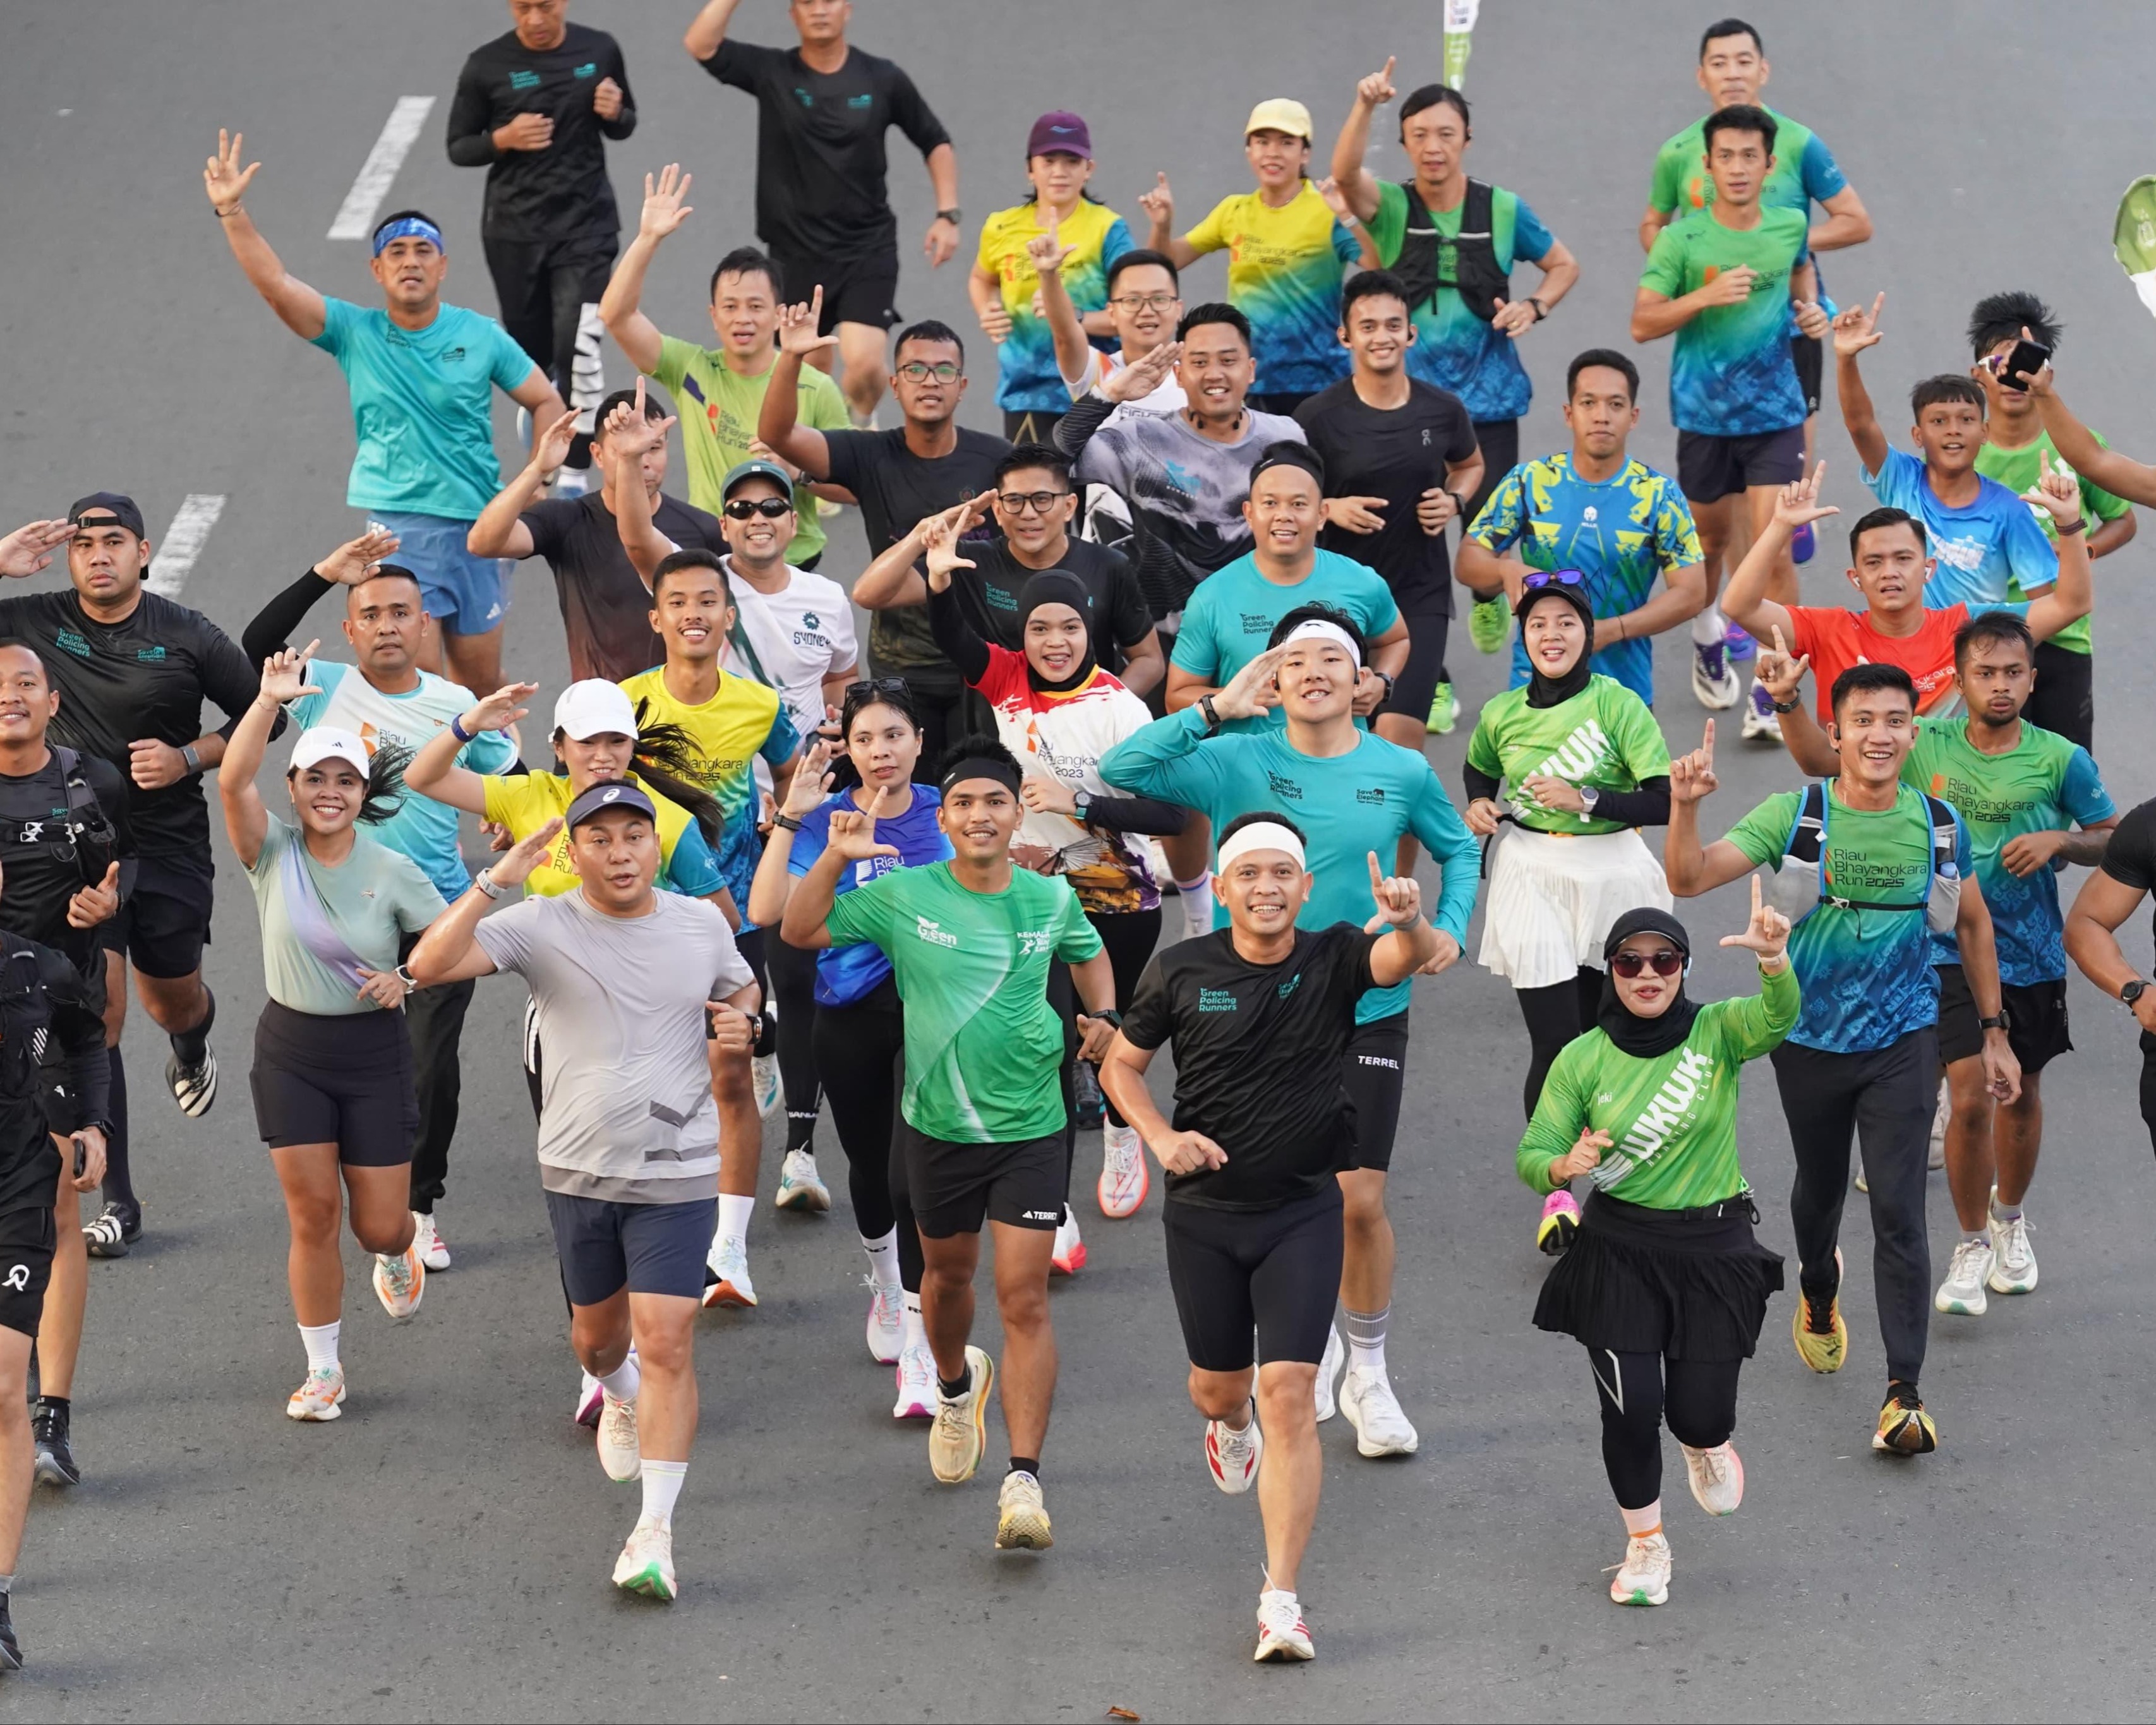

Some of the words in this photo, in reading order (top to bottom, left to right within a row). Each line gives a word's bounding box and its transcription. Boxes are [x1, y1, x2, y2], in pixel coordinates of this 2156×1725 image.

[985, 582, 1011, 597] Green
[986, 591, 1018, 606] Policing
[987, 598, 1019, 612] Runners
[1239, 613, 1266, 622] Green
[1243, 620, 1275, 631] Policing
[59, 627, 84, 642] Green
[57, 636, 90, 651] Policing
[1055, 766, 1085, 779] 2023
[1268, 771, 1294, 785] Green
[1271, 781, 1303, 794] Policing
[1948, 778, 1977, 796] Riau
[1947, 790, 2035, 812] Bhayangkara
[1975, 812, 2011, 824] 2025
[1834, 848, 1867, 862] Riau
[874, 856, 905, 870] Riau
[1834, 861, 1927, 878] Bhayangkara
[1834, 874, 1863, 887] Run
[1865, 877, 1905, 888] 2025
[1200, 988, 1229, 997] Green
[1199, 996, 1237, 1006] Policing
[1597, 1092, 1612, 1105] jeki
